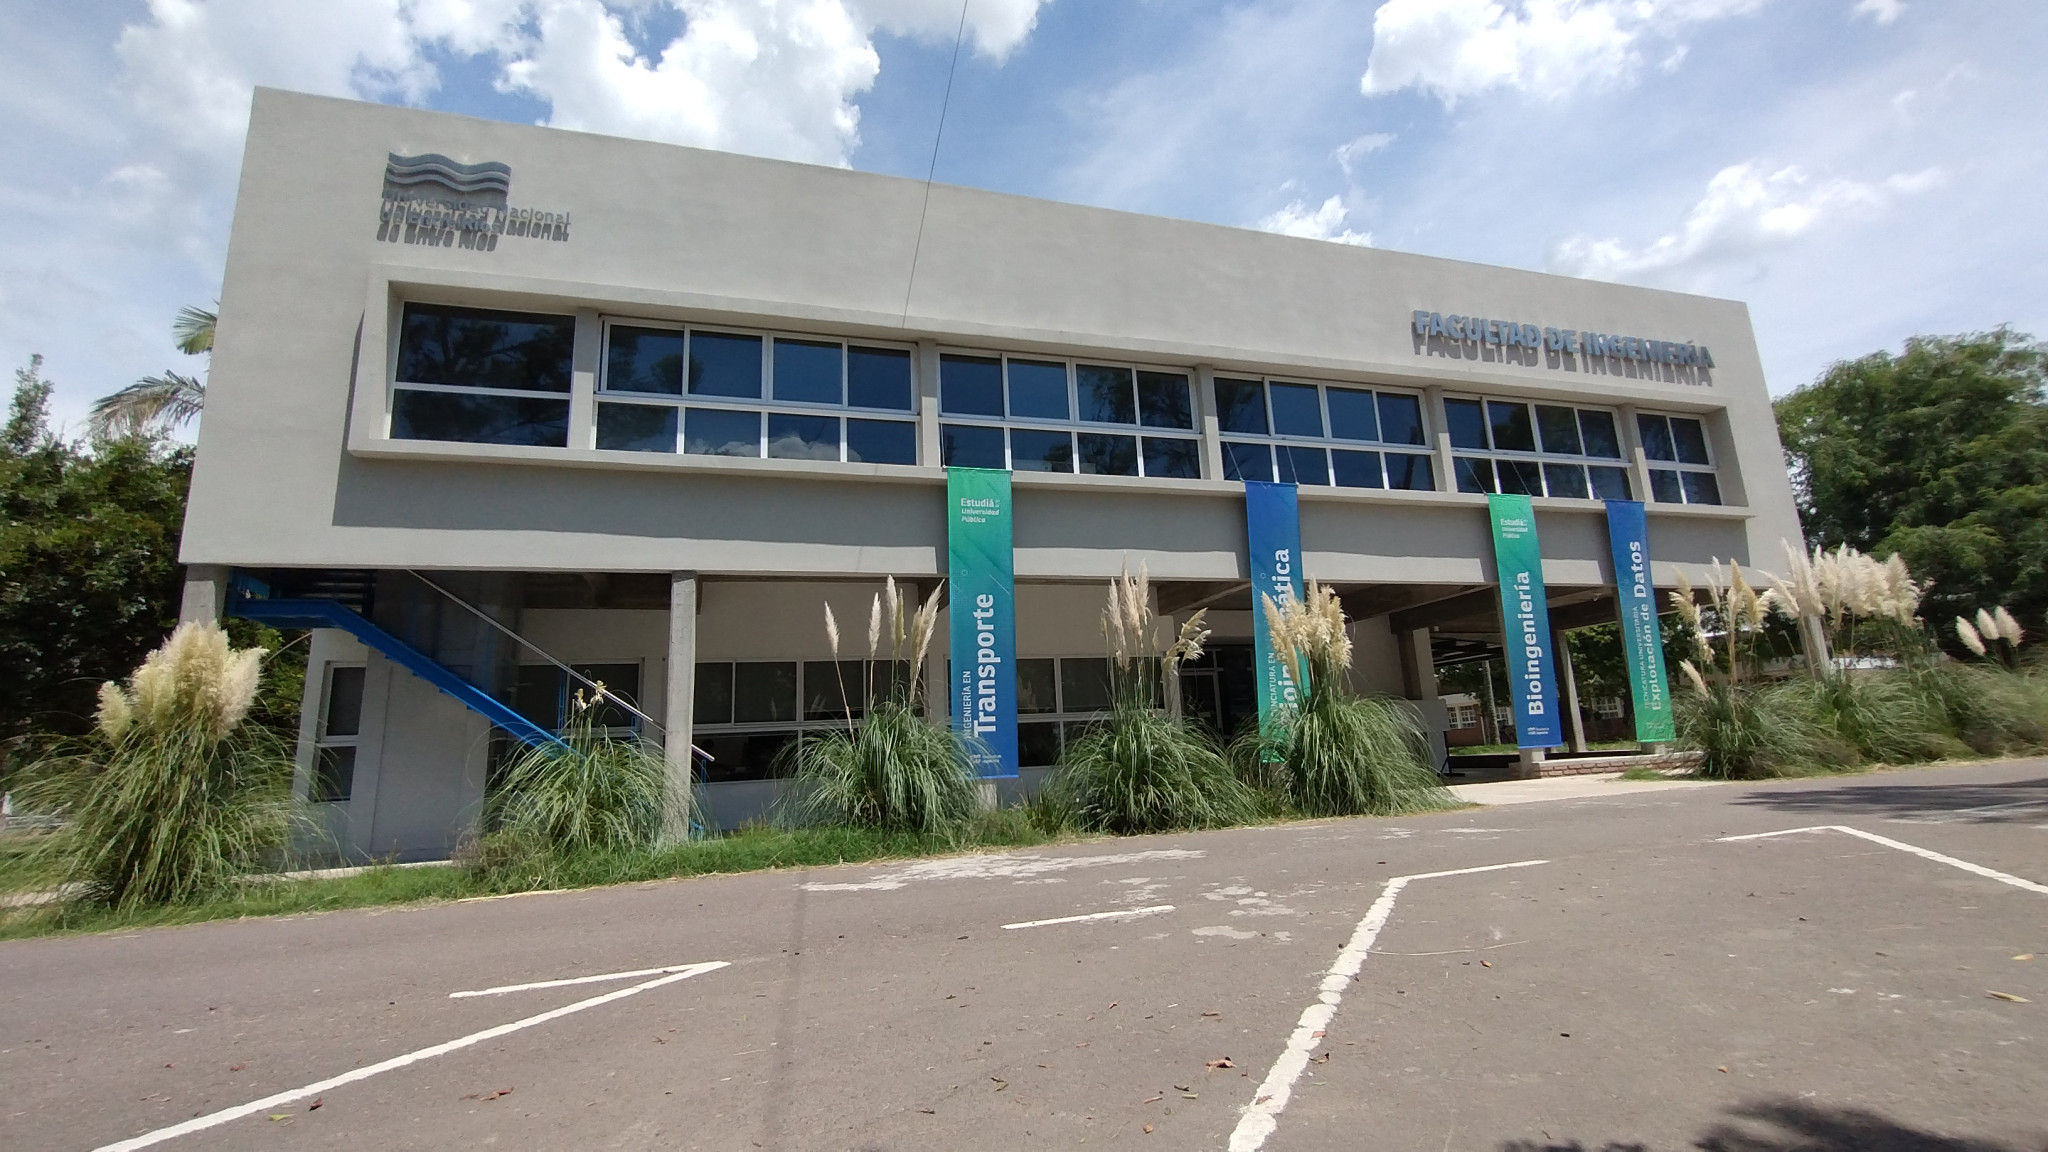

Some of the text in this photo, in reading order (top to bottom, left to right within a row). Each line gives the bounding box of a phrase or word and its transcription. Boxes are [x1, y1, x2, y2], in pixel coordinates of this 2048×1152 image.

[1412, 309, 1716, 369] FACULTAD DE INGENIERÍA
[960, 497, 995, 508] Estudiá
[961, 507, 1000, 516] Universidad
[961, 515, 986, 523] Pública
[1629, 541, 1647, 598] Datos
[1640, 603, 1650, 621] de
[1514, 571, 1545, 715] Bioingeniería
[973, 593, 1001, 737] Transporte
[1268, 652, 1276, 664] EN
[1643, 624, 1662, 710] Explotación
[962, 671, 971, 684] EN
